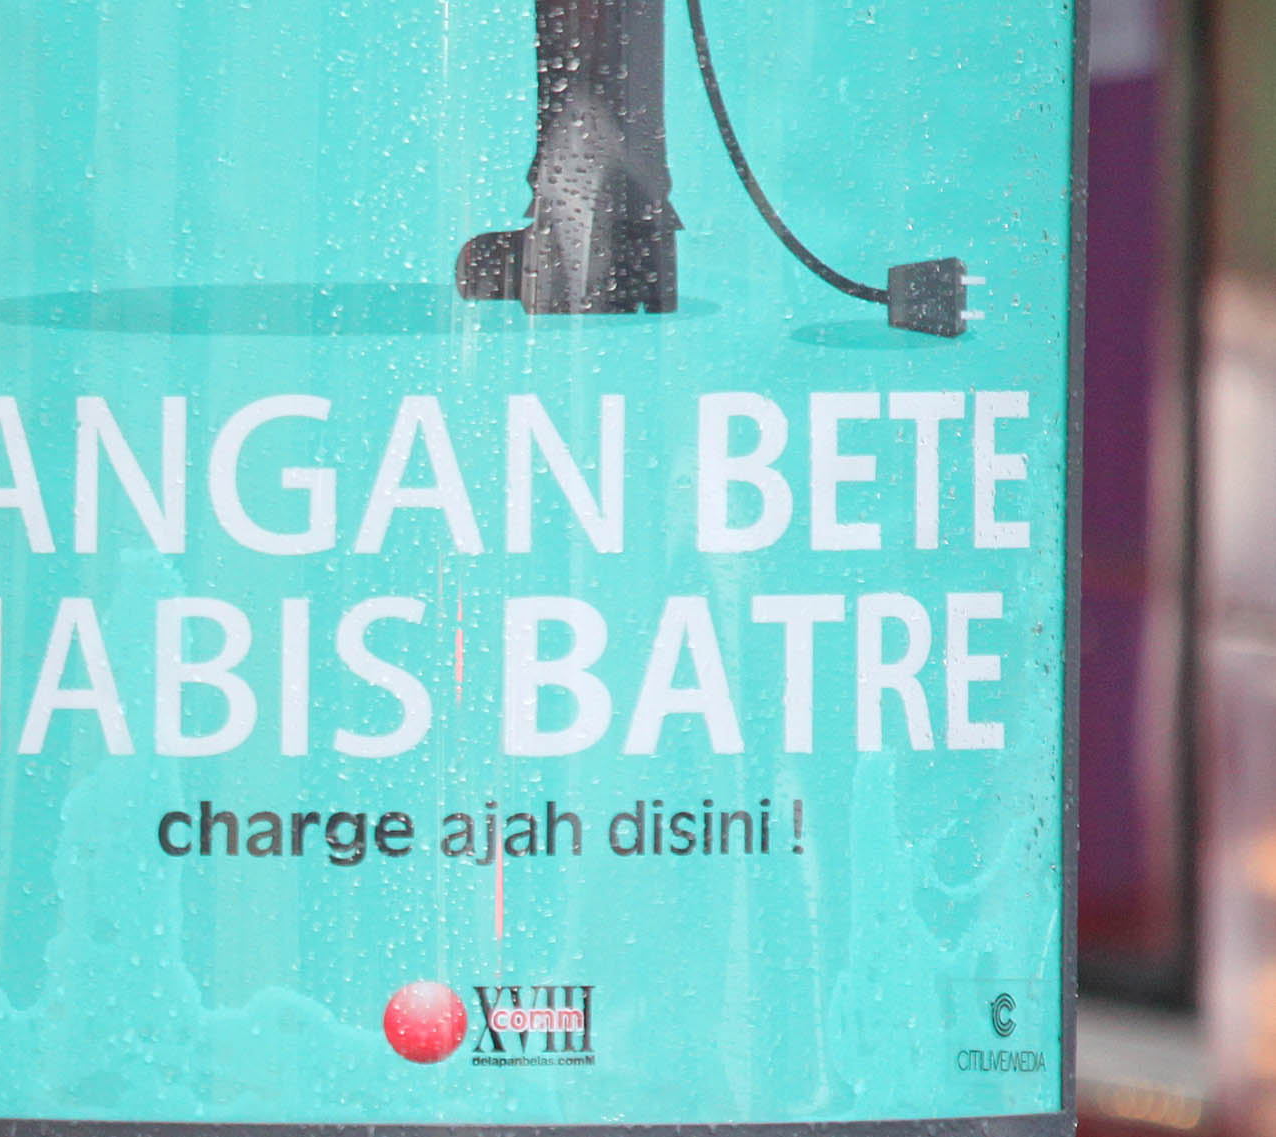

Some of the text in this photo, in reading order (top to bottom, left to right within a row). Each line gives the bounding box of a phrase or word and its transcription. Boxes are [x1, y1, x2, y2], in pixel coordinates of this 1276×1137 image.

[699, 390, 1031, 550] BETE
[504, 593, 1006, 755] BATRE
[157, 799, 416, 866] charge
[439, 799, 584, 865] ajah
[492, 1009, 585, 1032] comm
